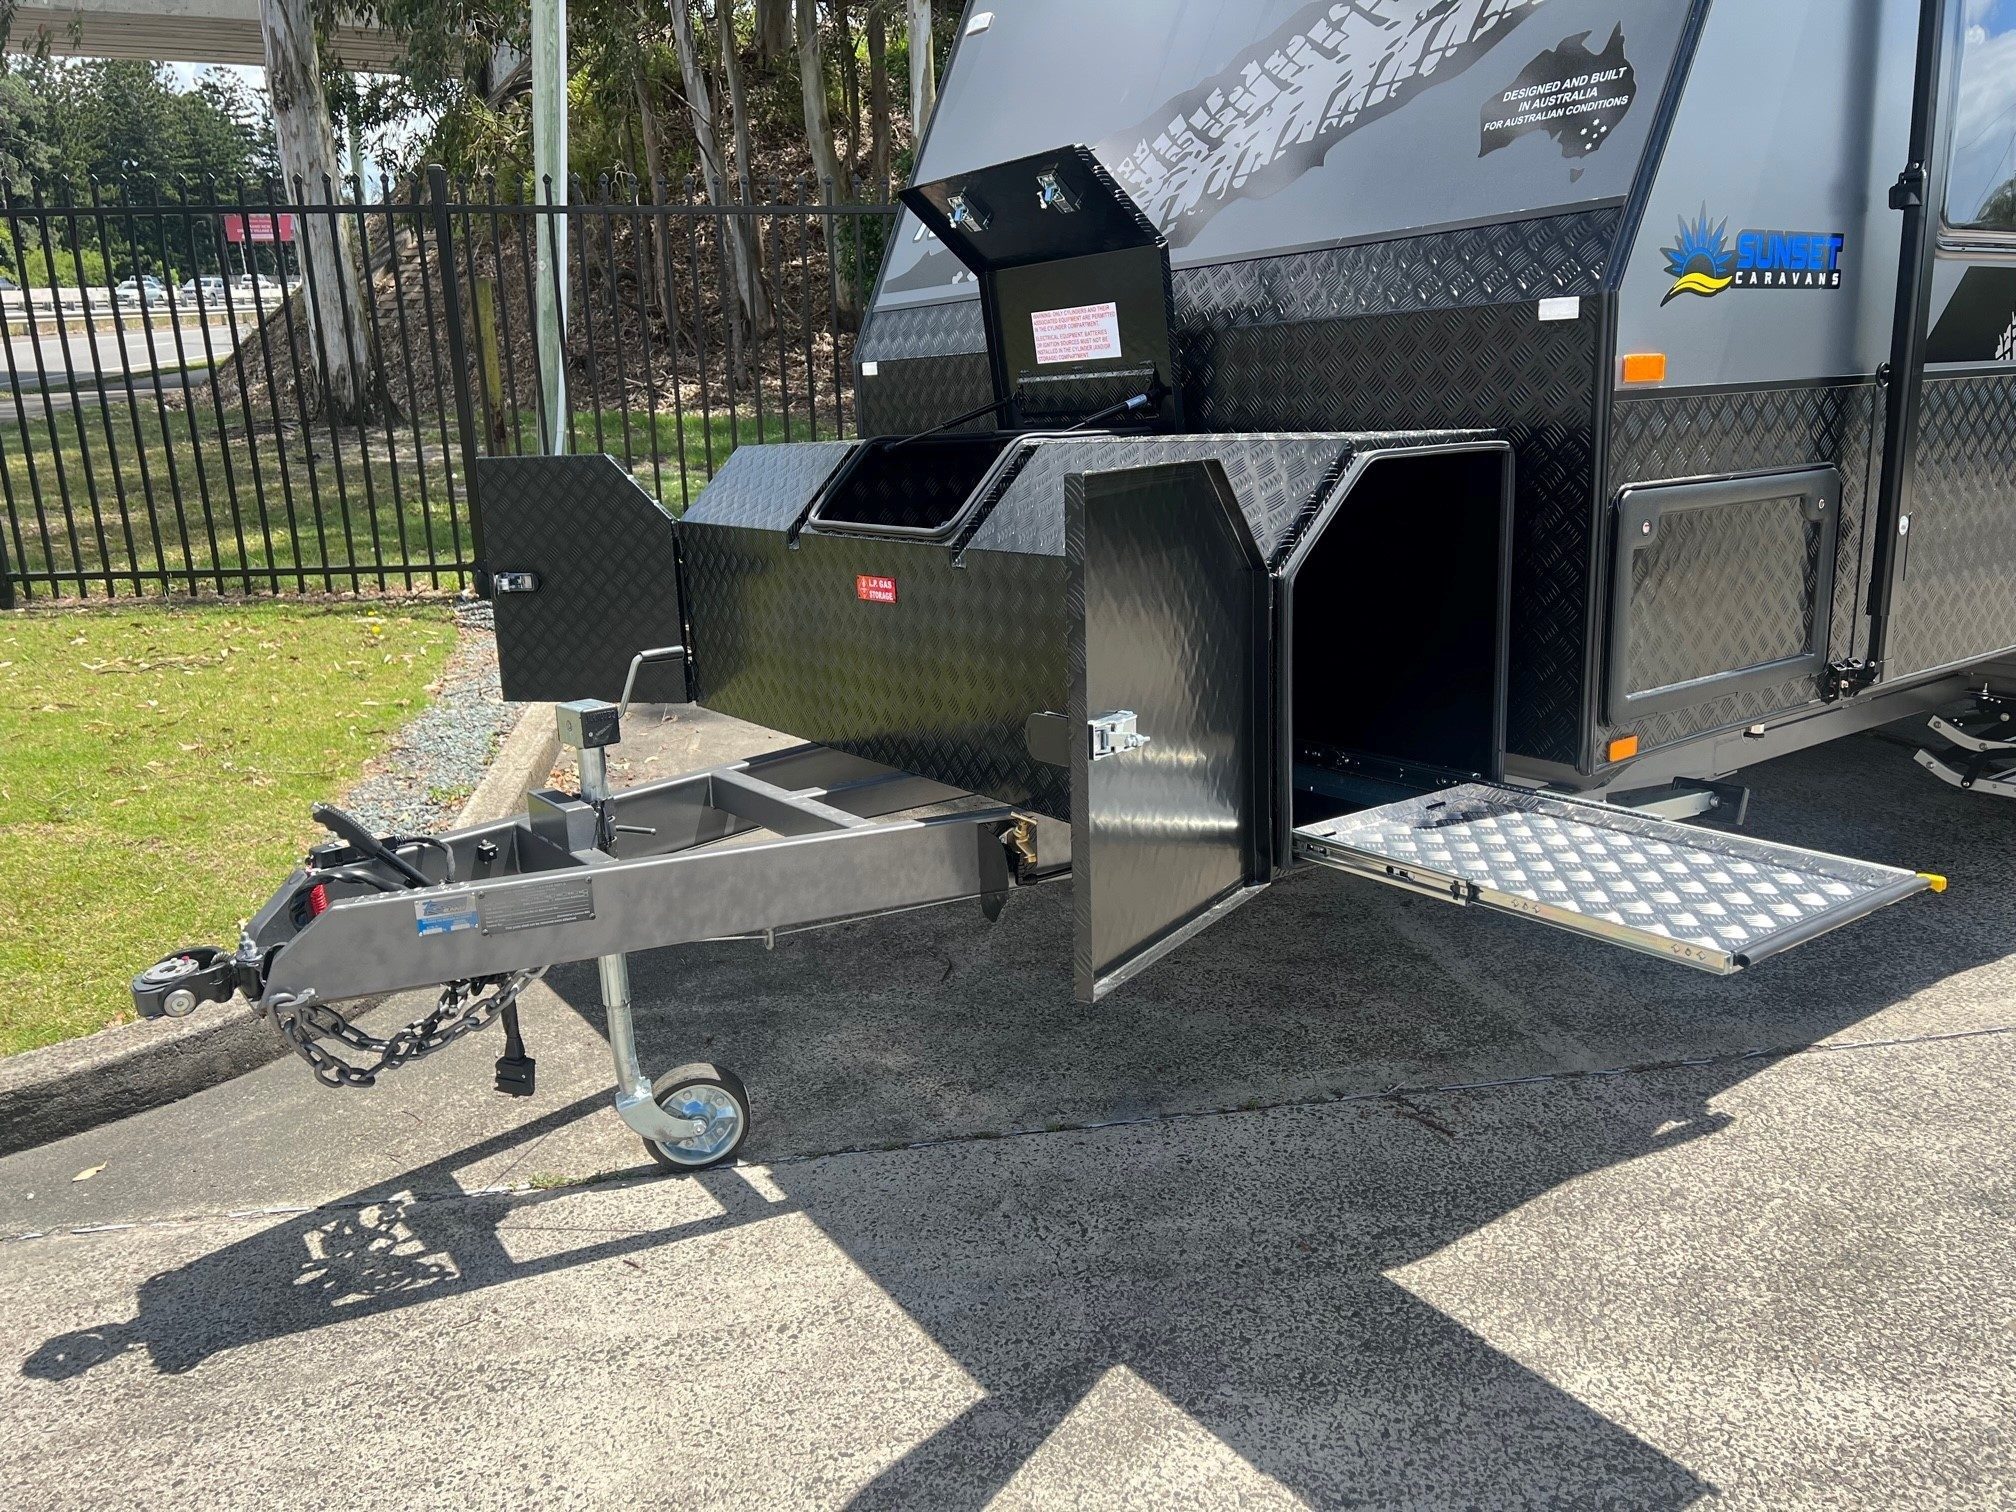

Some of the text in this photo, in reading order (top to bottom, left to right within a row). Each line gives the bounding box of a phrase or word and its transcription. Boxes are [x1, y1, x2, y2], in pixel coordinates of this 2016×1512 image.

[1502, 67, 1628, 102] DESIGNED AND BUILT
[1518, 87, 1598, 112] IN AUSTRALIA
[1483, 95, 1629, 132] FOR AUSTRALIAN CONDITIONS
[1737, 232, 1842, 270] SUNSET
[1735, 272, 1840, 286] CARAVANS
[1064, 308, 1086, 316] CYLINDERS
[1034, 318, 1058, 326] ASSOCIATED
[1059, 316, 1082, 324] EQUIPMENT
[1092, 311, 1116, 319] PERMITTED
[1047, 323, 1067, 331] CYLINDER
[1084, 329, 1108, 337] BATTERIES
[1072, 344, 1092, 352] CYLINDER
[878, 580, 892, 590] GAS
[869, 590, 894, 601] STORAGE
